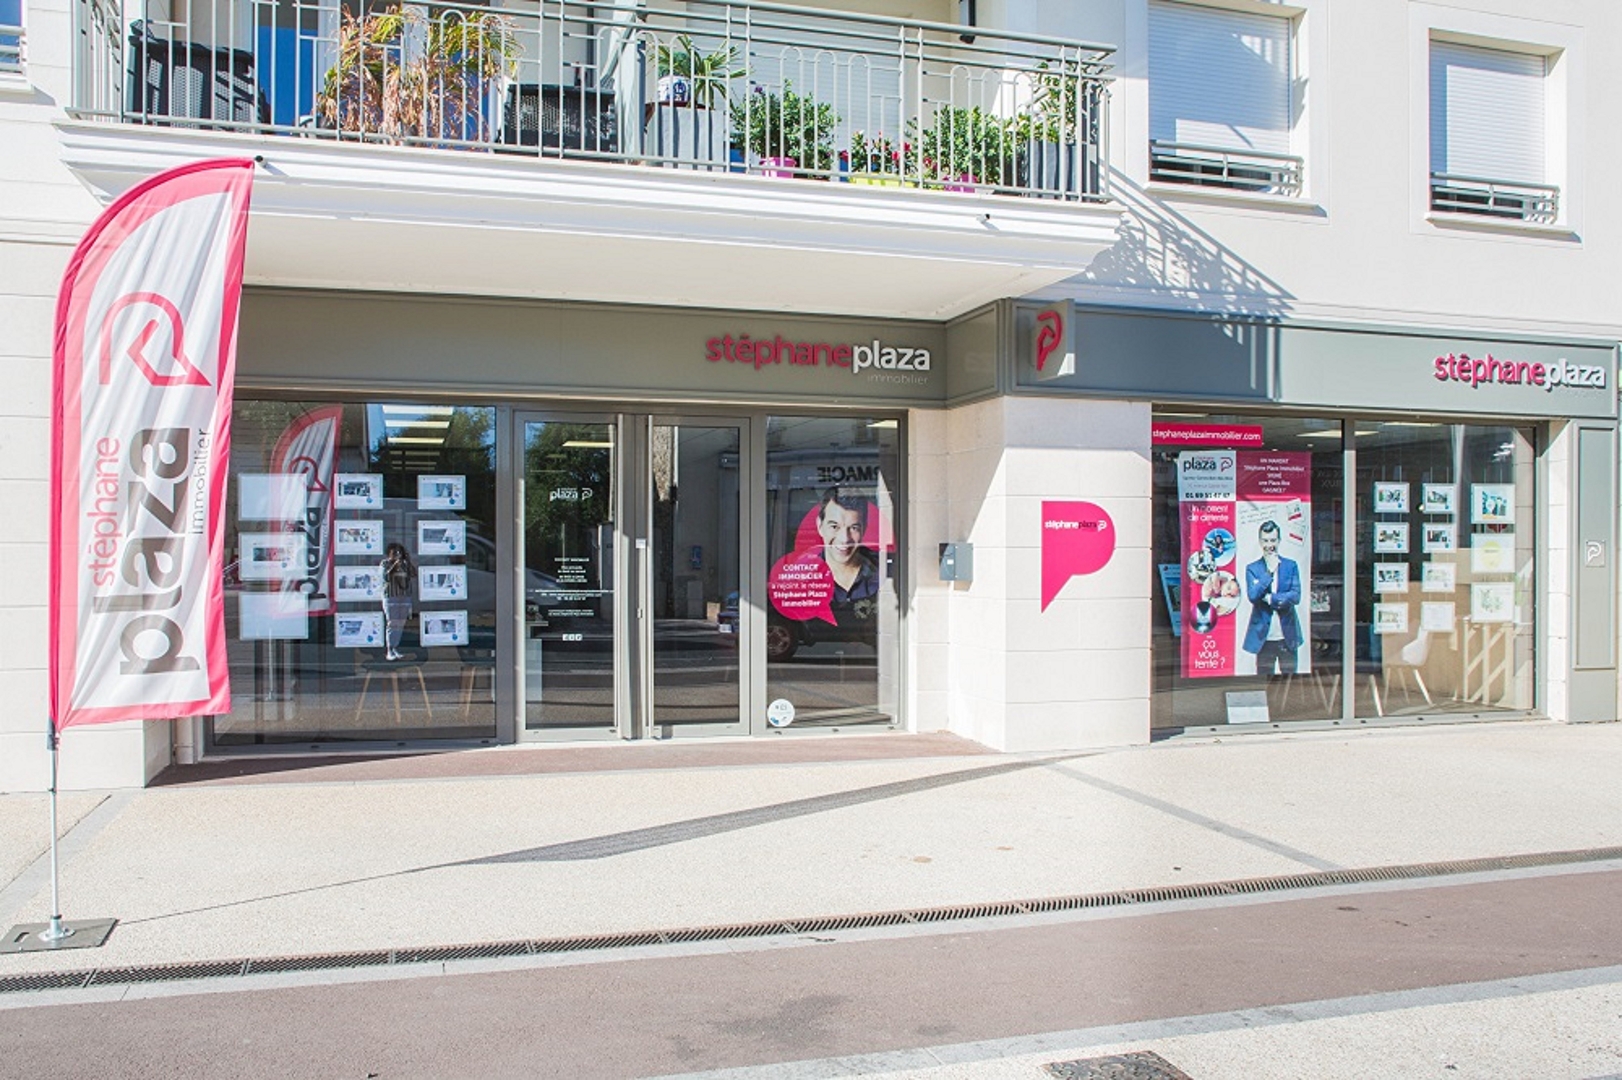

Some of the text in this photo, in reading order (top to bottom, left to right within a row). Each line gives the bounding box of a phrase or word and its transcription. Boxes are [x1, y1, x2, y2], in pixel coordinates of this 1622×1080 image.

[867, 372, 929, 385] immobilier
[1183, 456, 1217, 472] plaza
[188, 428, 211, 535] immobilier
[549, 487, 579, 501] plaza
[93, 427, 201, 675] plaza
[783, 563, 819, 571] CONTACT
[778, 572, 823, 580] IMMOBILIER
[777, 582, 799, 591] rejoint
[773, 590, 828, 600] Stéphane Plaza
[1198, 650, 1220, 659] vous
[1195, 658, 1226, 669] tente ?
